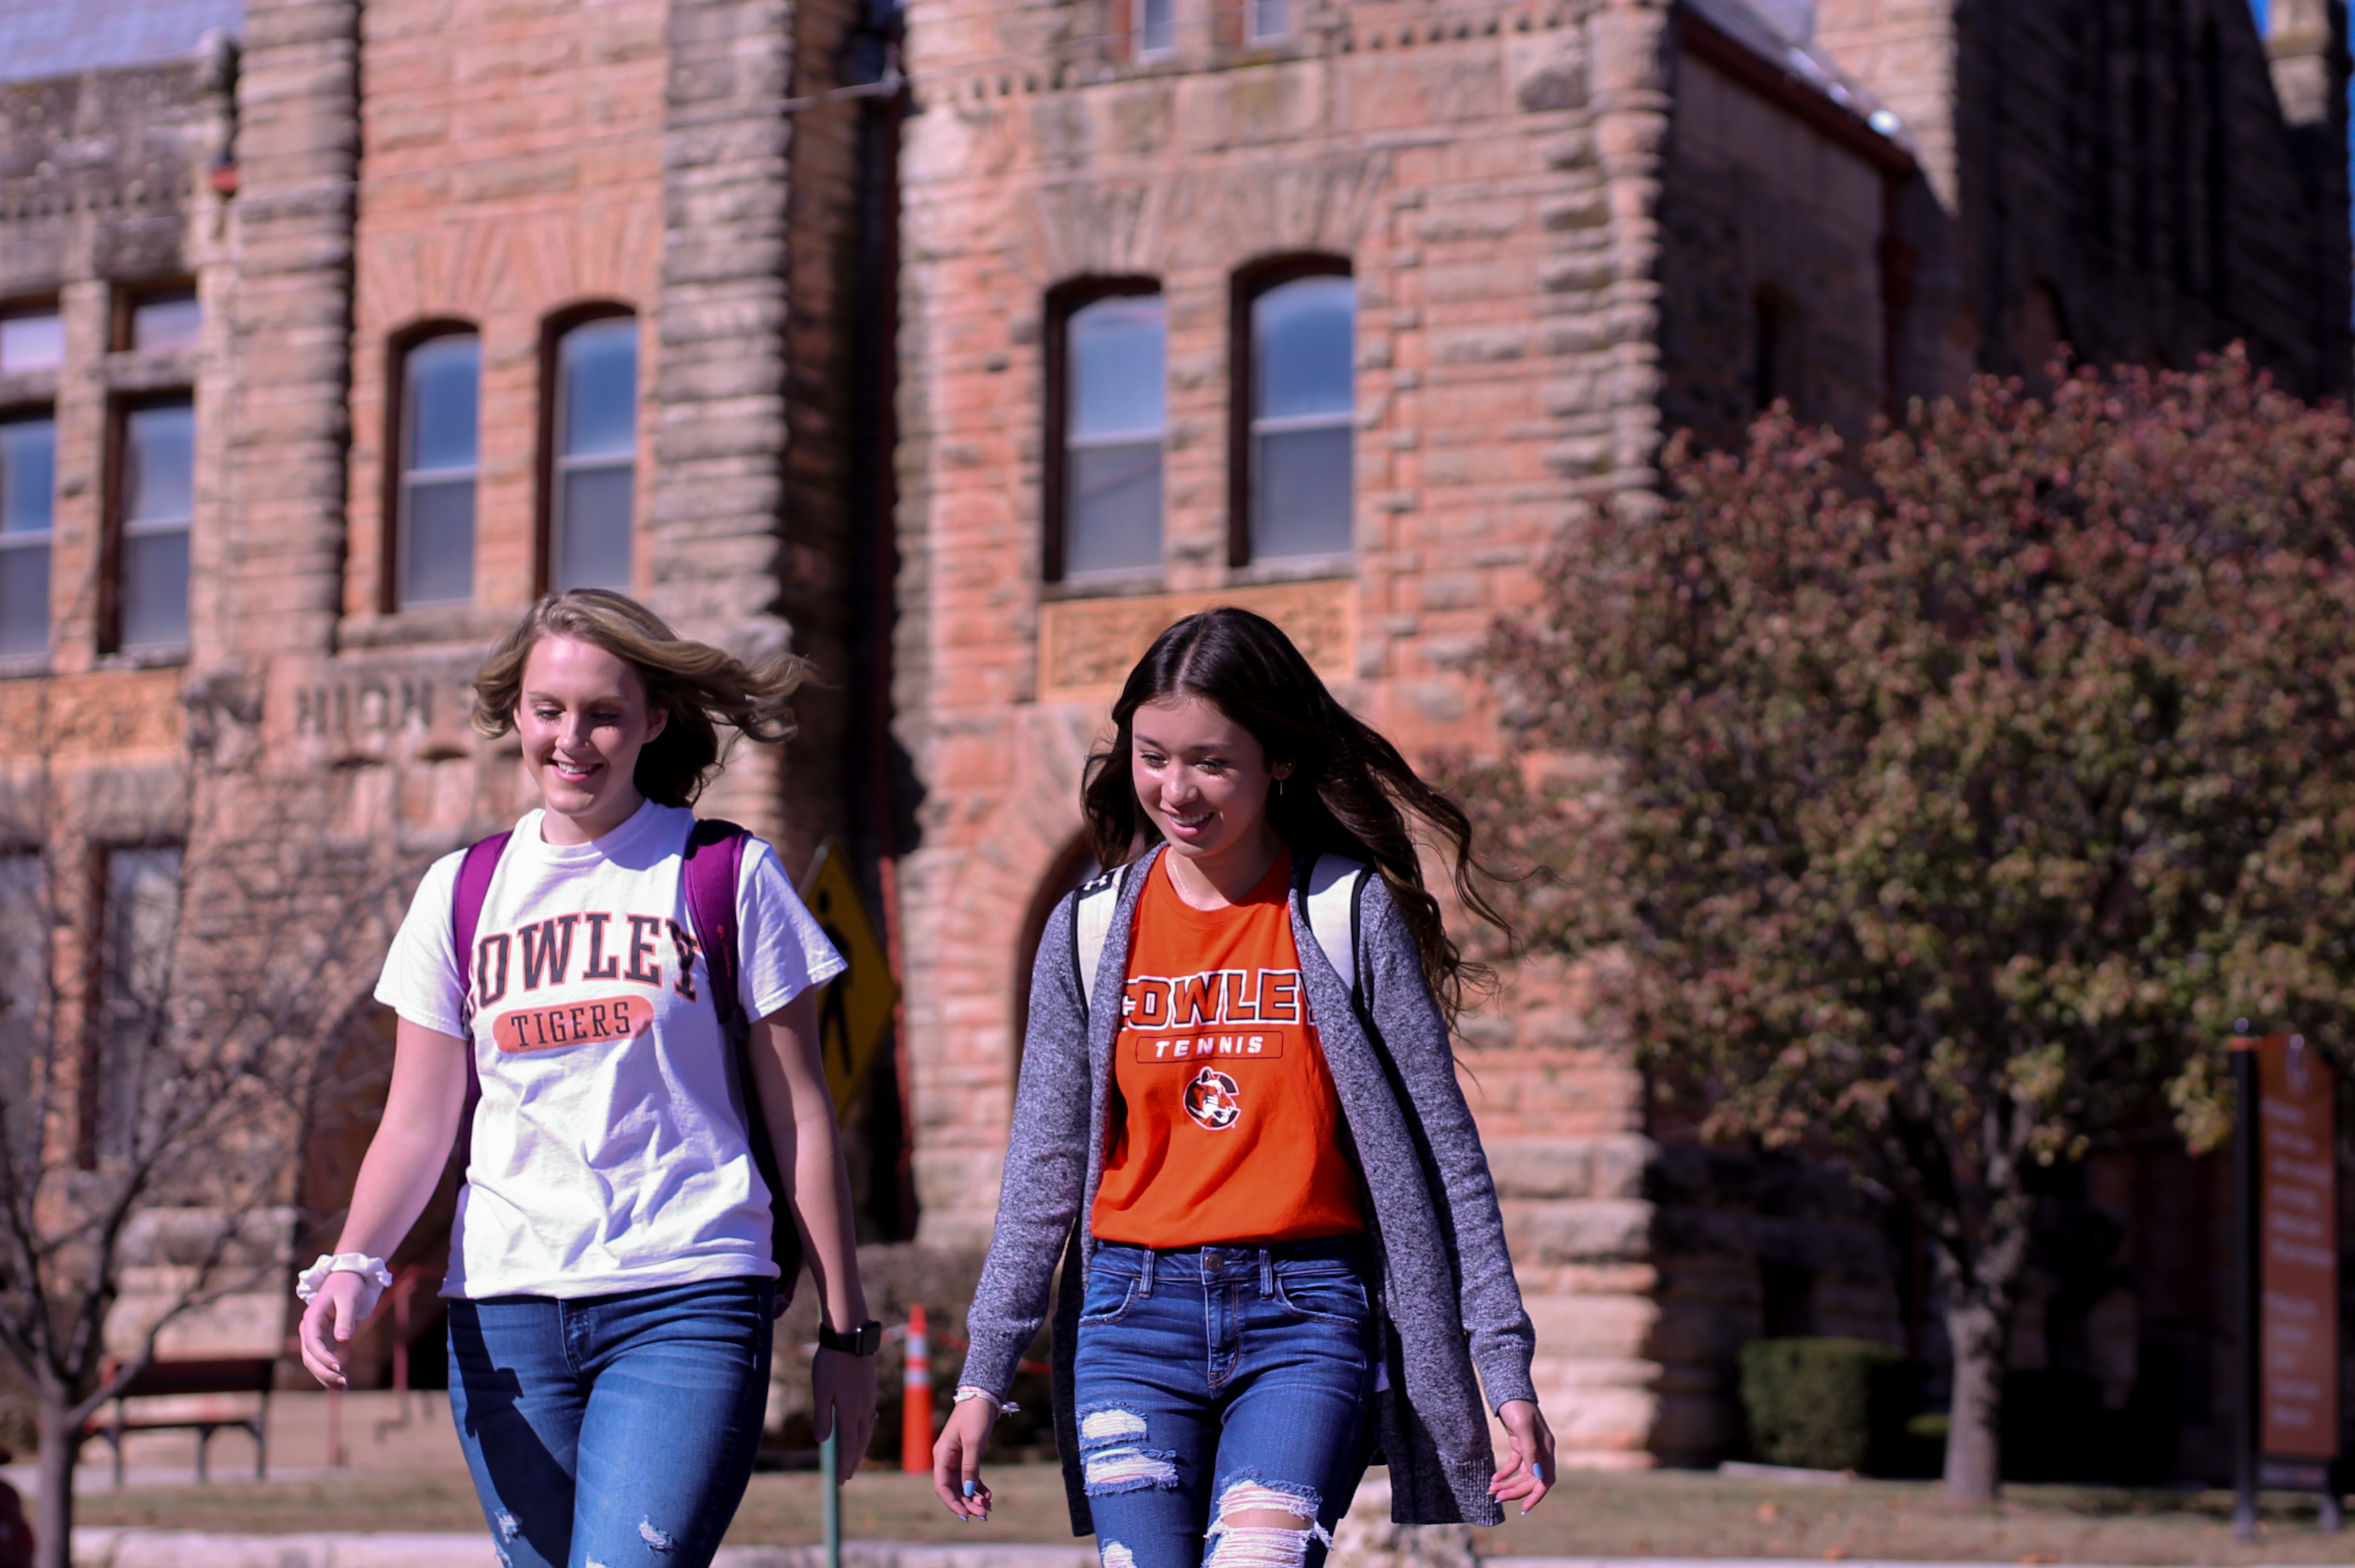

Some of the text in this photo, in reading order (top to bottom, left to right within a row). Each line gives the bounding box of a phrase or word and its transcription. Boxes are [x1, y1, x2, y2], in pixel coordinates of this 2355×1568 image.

[467, 911, 701, 1019] OWLEY
[510, 1001, 631, 1048] TIGERS
[1121, 968, 1316, 1031] OWLE
[1155, 1036, 1264, 1058] TENNIS
